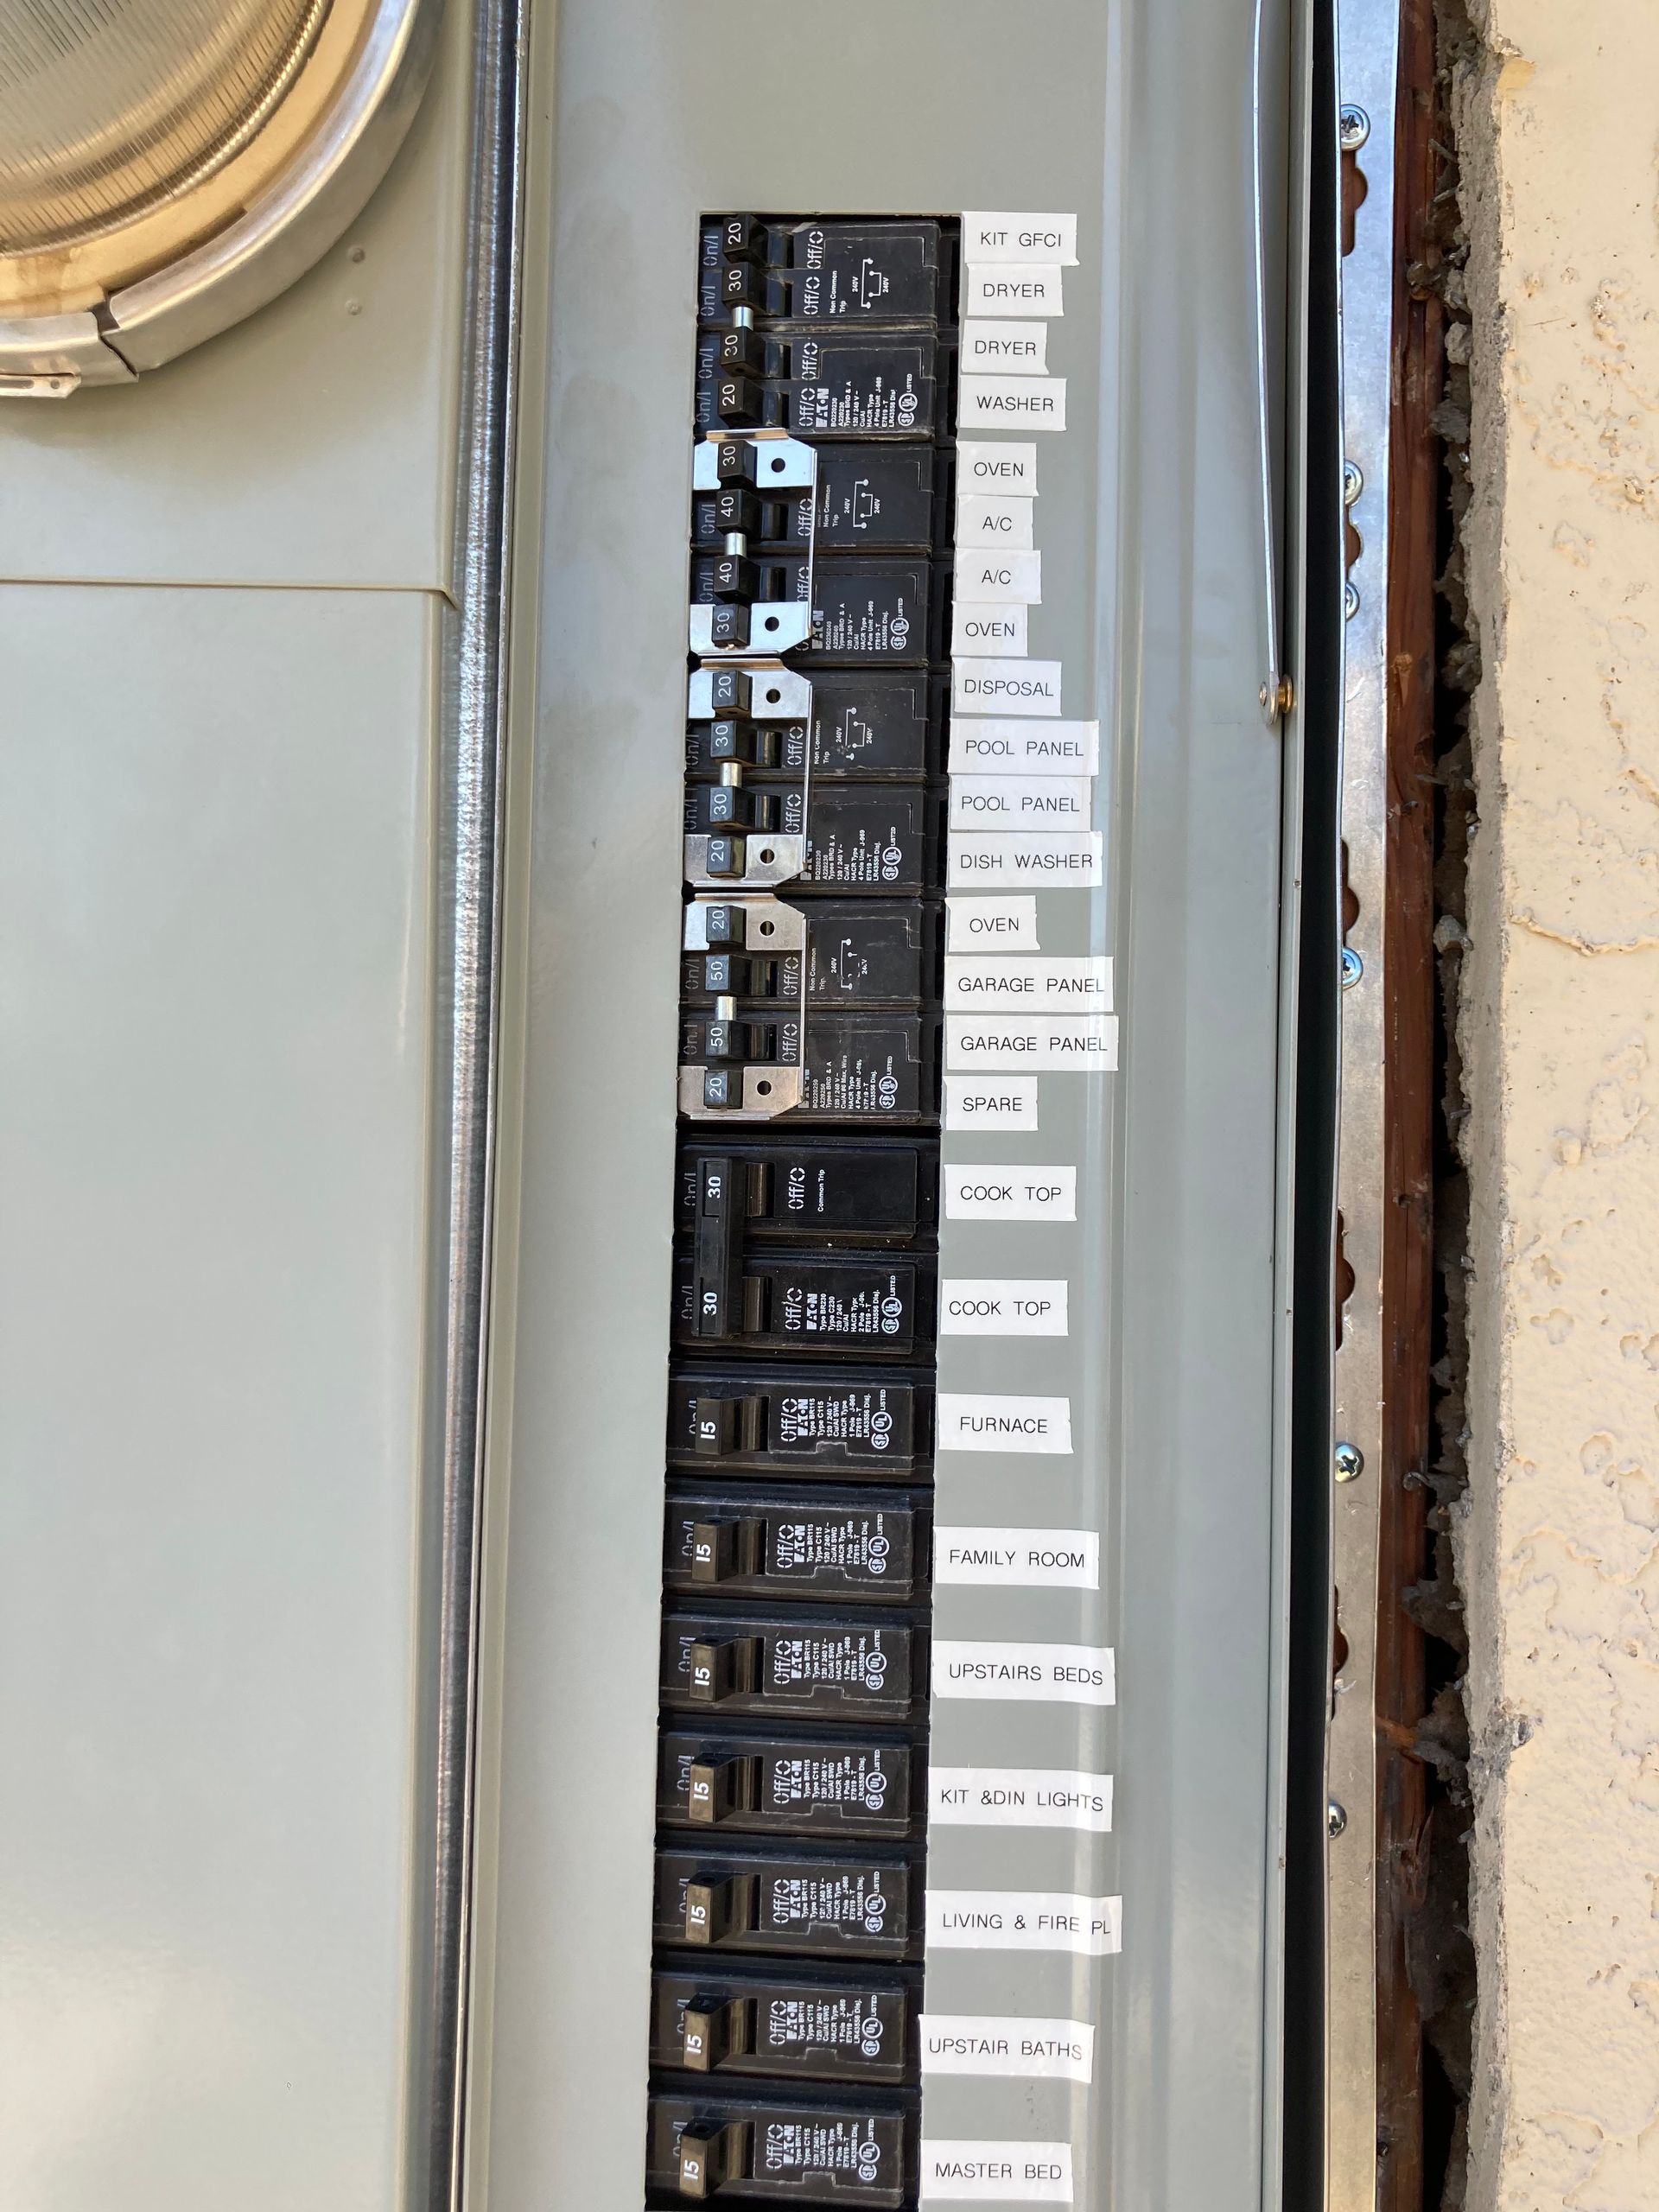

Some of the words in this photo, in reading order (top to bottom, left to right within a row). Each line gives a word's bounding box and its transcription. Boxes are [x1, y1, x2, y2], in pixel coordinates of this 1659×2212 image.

[728, 223, 741, 245] 20
[980, 231, 1009, 246] KIT
[1018, 232, 1062, 248] GFCI
[728, 270, 742, 292] 30
[982, 283, 1045, 298] DRYER
[725, 335, 738, 356] 30
[975, 340, 1036, 356] DRYER
[722, 385, 735, 406] 20
[976, 395, 1054, 412] WASHER
[816, 388, 829, 427] EATON
[722, 446, 735, 466] 30
[973, 461, 1024, 477] OVEN
[721, 497, 734, 517] 40
[982, 515, 1013, 532] A/C
[719, 563, 732, 583] 40
[981, 569, 1012, 585] A/C
[717, 613, 730, 633] 30
[964, 621, 1015, 638] OVEN
[718, 676, 731, 697] 20
[964, 678, 1054, 697] DISPOSAL
[715, 725, 728, 747] 30
[965, 740, 1015, 756] POOL
[1026, 741, 1084, 757] PANEL
[714, 794, 727, 815] 30
[961, 795, 1011, 811] POOL
[1021, 797, 1080, 812] PANEL
[711, 840, 724, 862] 20
[960, 854, 1002, 870] DISH
[1014, 854, 1093, 870] WASHER
[712, 910, 725, 929] 20
[969, 917, 1020, 933] OVEN
[710, 961, 723, 981] 50
[957, 976, 1035, 993] GARAGE
[1046, 977, 1105, 993] PANEL
[710, 1027, 723, 1046] 50
[960, 1035, 1038, 1052] GARAGE
[1049, 1036, 1109, 1052] PANEL
[709, 1077, 722, 1097] 20
[962, 1096, 1023, 1112] SPARE
[708, 1177, 721, 1198] 30
[960, 1185, 1014, 1201] COOK
[1023, 1186, 1062, 1202] TOP
[703, 1293, 717, 1315] 30
[807, 1294, 817, 1330] EATON
[949, 1300, 1002, 1316] COOK
[1012, 1300, 1052, 1317] TOP
[798, 1399, 808, 1436] EATON
[960, 1416, 1048, 1434] FURNACE
[701, 1421, 716, 1440] 15
[696, 1544, 710, 1562] 15
[794, 1525, 805, 1562] EATON
[949, 1548, 1016, 1566] FAMILY
[1028, 1551, 1084, 1568] ROOM
[791, 1641, 803, 1678] EATON
[695, 1667, 710, 1686] 15
[949, 1662, 1042, 1681] UPSTAIRS
[1053, 1666, 1103, 1686] BEDS
[791, 1761, 802, 1798] EATON
[694, 1782, 709, 1801] 15
[941, 1789, 970, 1804] KIT
[980, 1789, 1025, 1806] &DIN
[1037, 1790, 1104, 1812] LIGHTS
[790, 1880, 801, 1918] EATON
[691, 1905, 706, 1926] 15
[943, 1912, 1003, 1929] LIVING
[1014, 1914, 1027, 1930] &
[1038, 1915, 1080, 1932] FIRE
[1091, 1919, 1111, 1936] PL
[787, 2001, 798, 2039] EATON
[687, 2034, 702, 2055] 15
[929, 2037, 1009, 2056] UPSTAIR
[1020, 2040, 1082, 2061] BATHS
[784, 2125, 795, 2164] EATON
[683, 2159, 699, 2181] 15
[935, 2162, 1013, 2179] MASTER
[1024, 2164, 1062, 2180] BED
